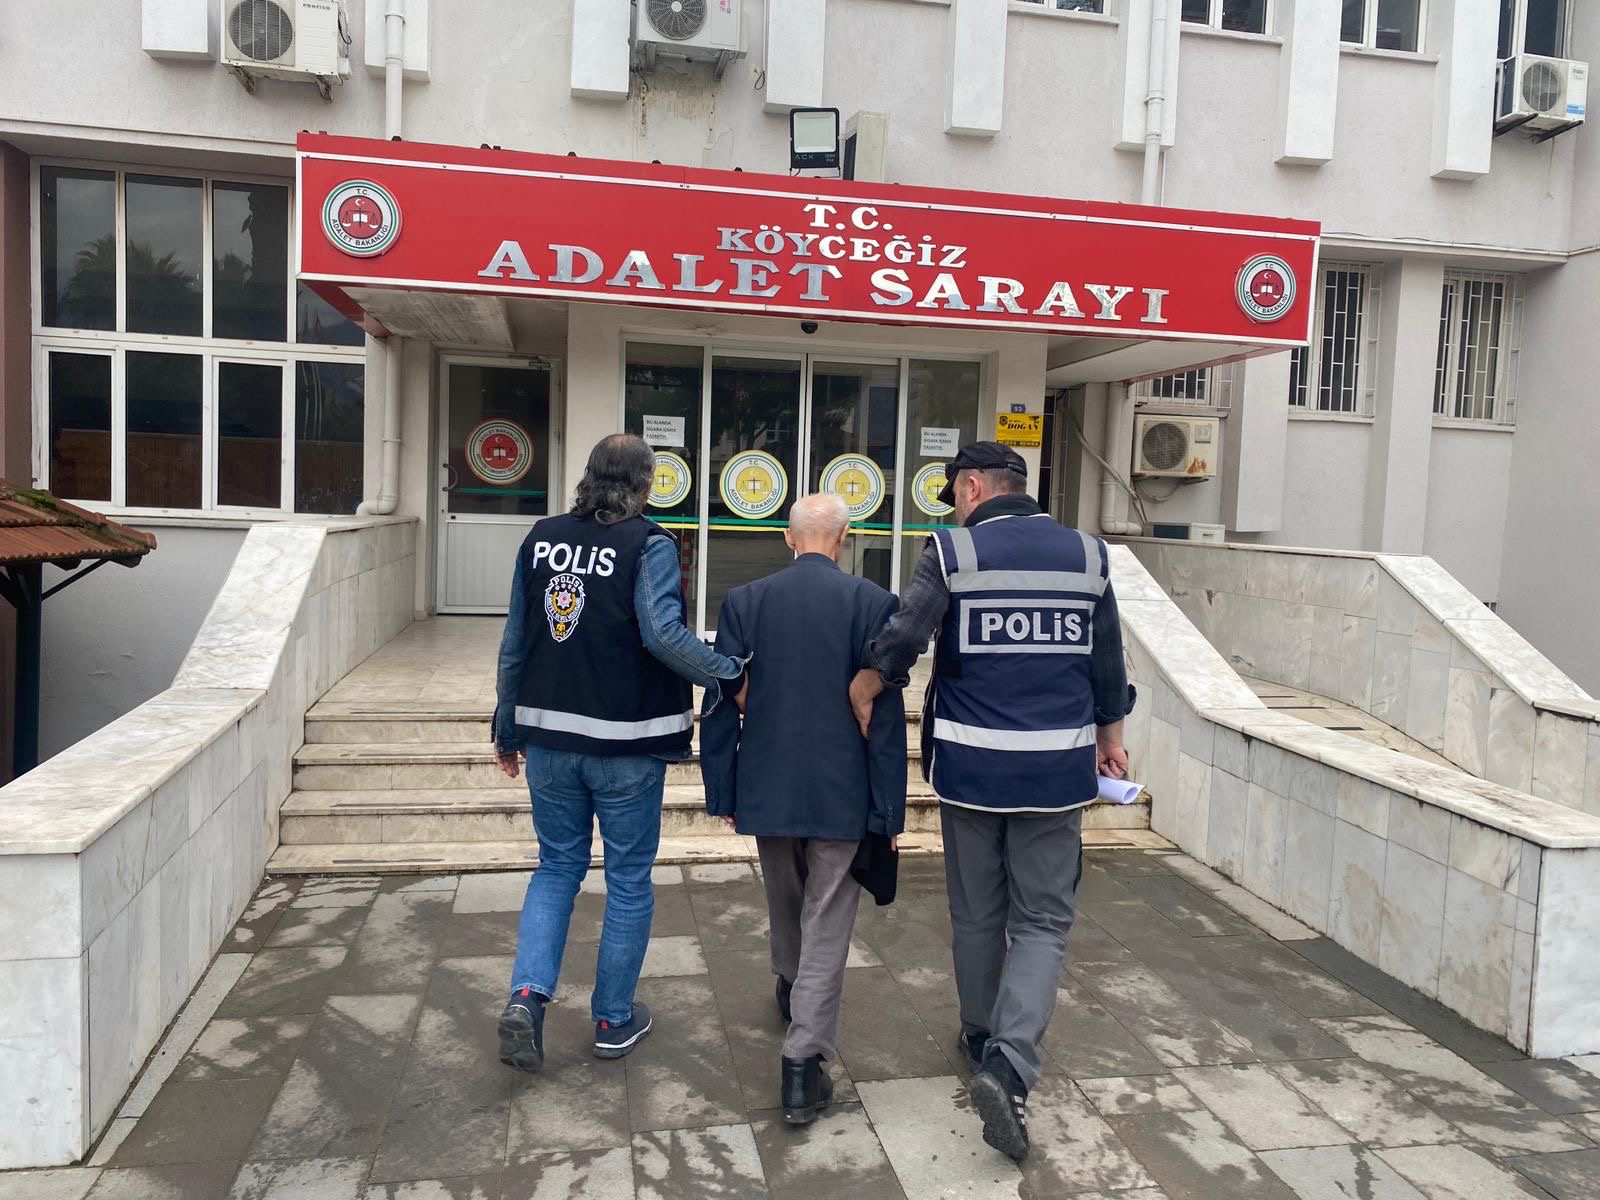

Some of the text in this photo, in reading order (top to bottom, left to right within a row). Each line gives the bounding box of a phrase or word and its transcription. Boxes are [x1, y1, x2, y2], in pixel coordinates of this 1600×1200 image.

[331, 218, 353, 243] ADALET
[803, 203, 893, 231] T.C.
[716, 223, 968, 269] KÖYCEĞİZ
[477, 239, 1170, 324] ADALET SARAYI
